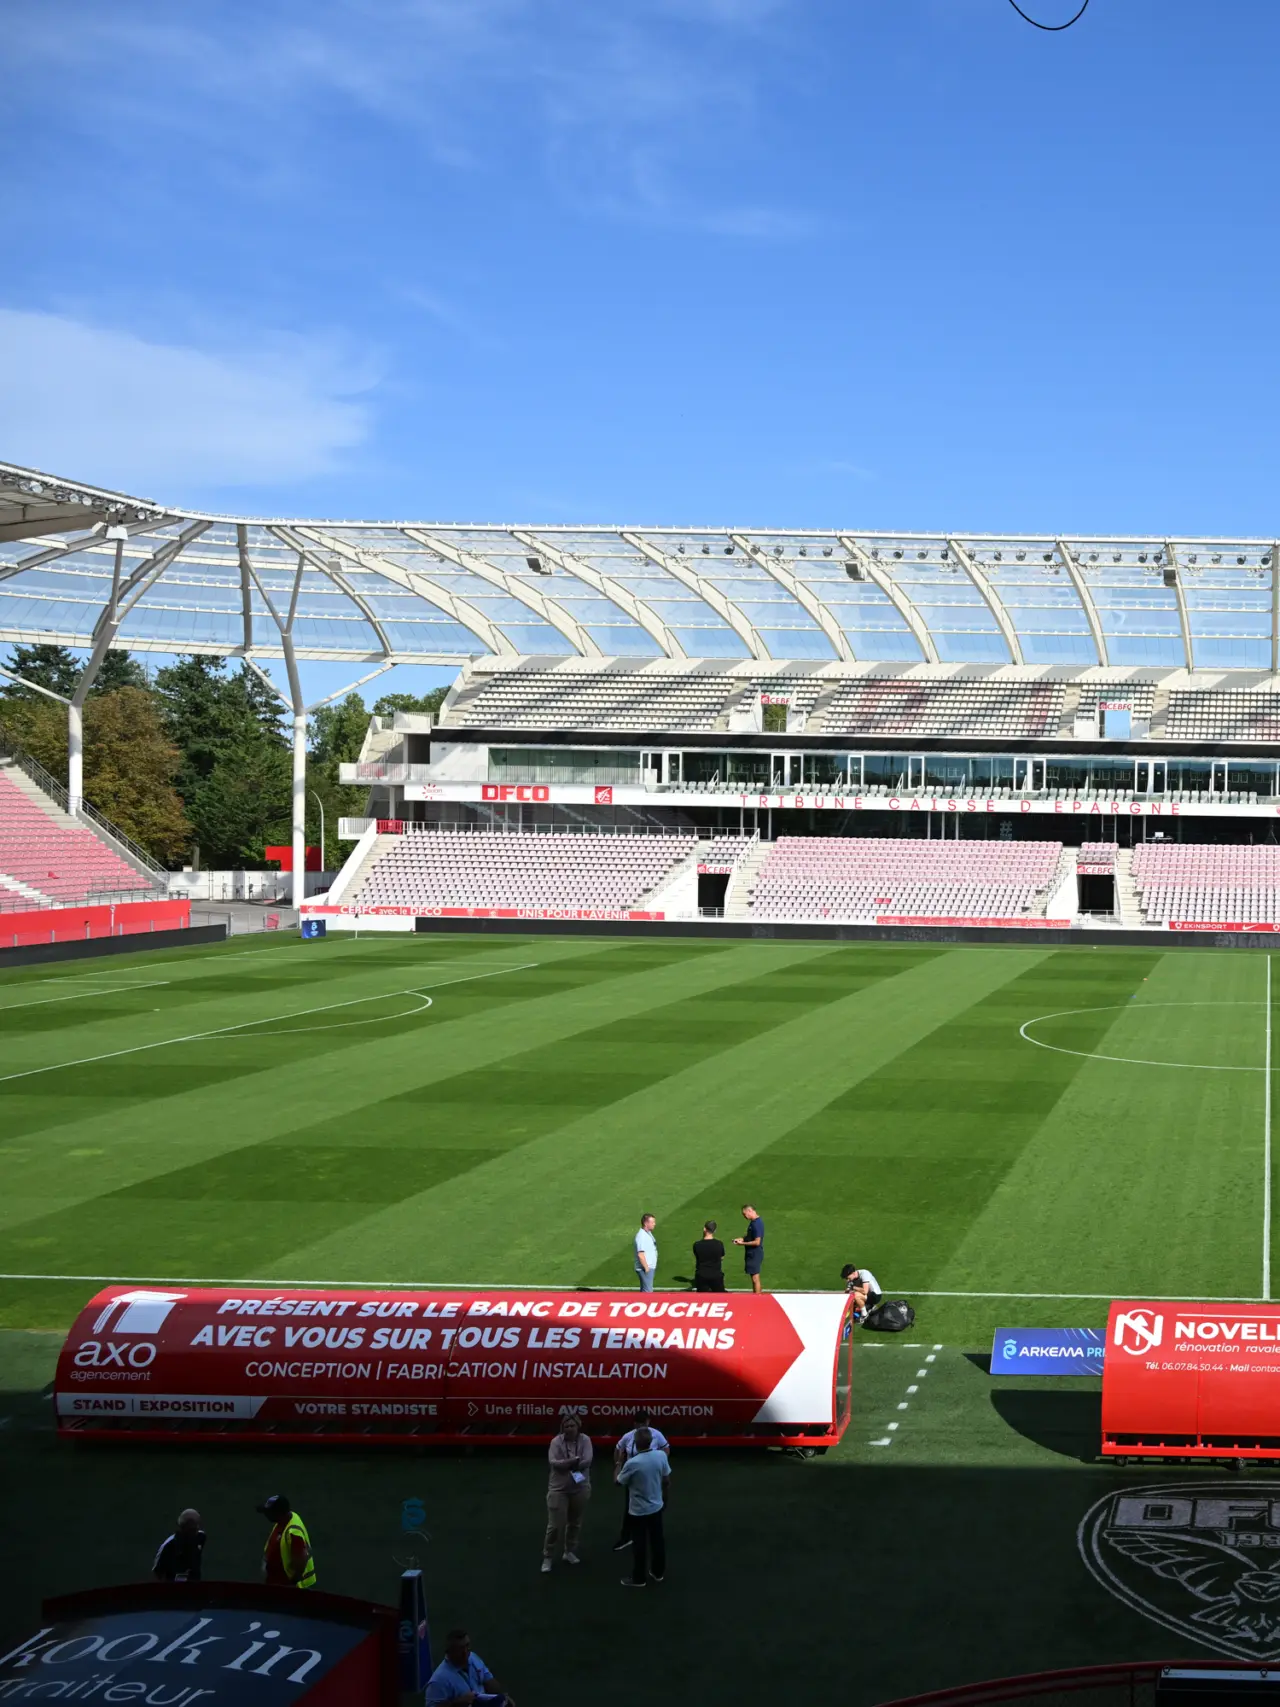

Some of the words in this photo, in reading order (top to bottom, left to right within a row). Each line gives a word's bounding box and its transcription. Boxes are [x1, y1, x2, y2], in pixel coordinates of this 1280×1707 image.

[482, 785, 550, 801] DFCO
[740, 796, 863, 810] TRIBUNE
[888, 798, 994, 812] CAISSE
[1020, 800, 1031, 812] D
[1055, 801, 1180, 816] EPARGNE
[1086, 866, 1114, 874] CEBFC
[340, 905, 376, 914] CEBFC
[410, 907, 442, 916] DFCO
[518, 908, 544, 918] UNIS
[546, 910, 578, 918] POUR
[581, 910, 630, 920] L'AVENIR
[216, 1296, 356, 1316] PRÉSENT
[356, 1301, 421, 1318] SUR
[422, 1302, 462, 1318] LE
[466, 1300, 554, 1318] BANC
[558, 1302, 602, 1317] DE
[609, 1302, 733, 1321] TOUCHE,
[190, 1325, 277, 1348] AVEC
[284, 1326, 366, 1348] VOUS
[370, 1327, 432, 1350] SUR
[440, 1327, 522, 1350] TOUS
[527, 1328, 582, 1349] LES
[590, 1328, 736, 1350] TERRAINS
[74, 1340, 156, 1368] axo
[1018, 1346, 1084, 1358] ARKEMA
[1174, 1342, 1240, 1353] rénovation
[245, 1361, 370, 1379] CONCEPTION
[386, 1362, 517, 1380] FABRICATION
[532, 1362, 668, 1379] INSTALLATION
[1230, 1363, 1250, 1372] Mail
[70, 1370, 152, 1382] agencement
[73, 1399, 126, 1411] STAND
[140, 1400, 234, 1412] EXPOSITION
[295, 1403, 346, 1415] VOTRE
[352, 1404, 438, 1416] STANDISTE
[485, 1404, 513, 1416] Une
[516, 1403, 554, 1416] filiale
[558, 1404, 588, 1416] AVS
